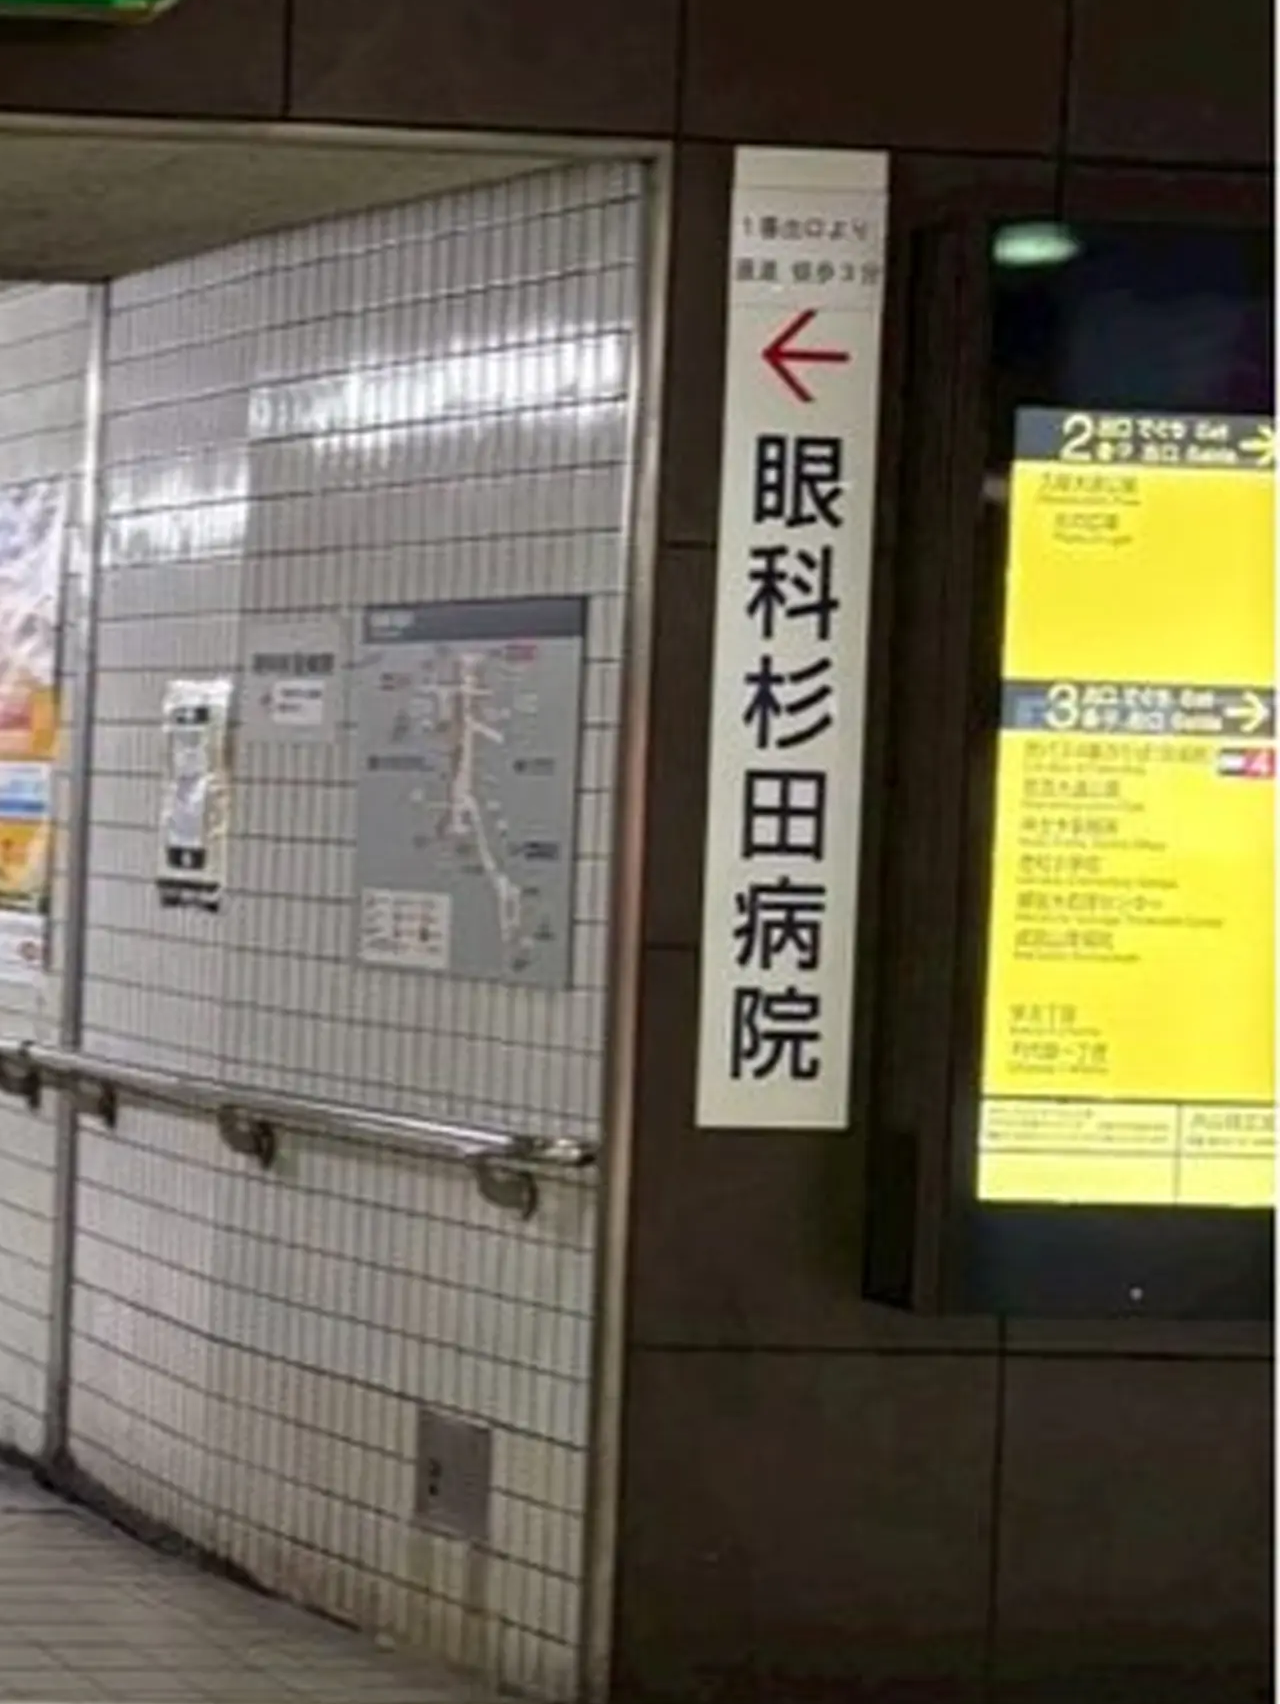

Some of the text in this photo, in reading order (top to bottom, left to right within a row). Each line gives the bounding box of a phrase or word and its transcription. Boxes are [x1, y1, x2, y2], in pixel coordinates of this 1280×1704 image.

[1060, 413, 1094, 462] 2
[1045, 683, 1079, 729] 3
[729, 433, 845, 1083] 眼科杉田病院
